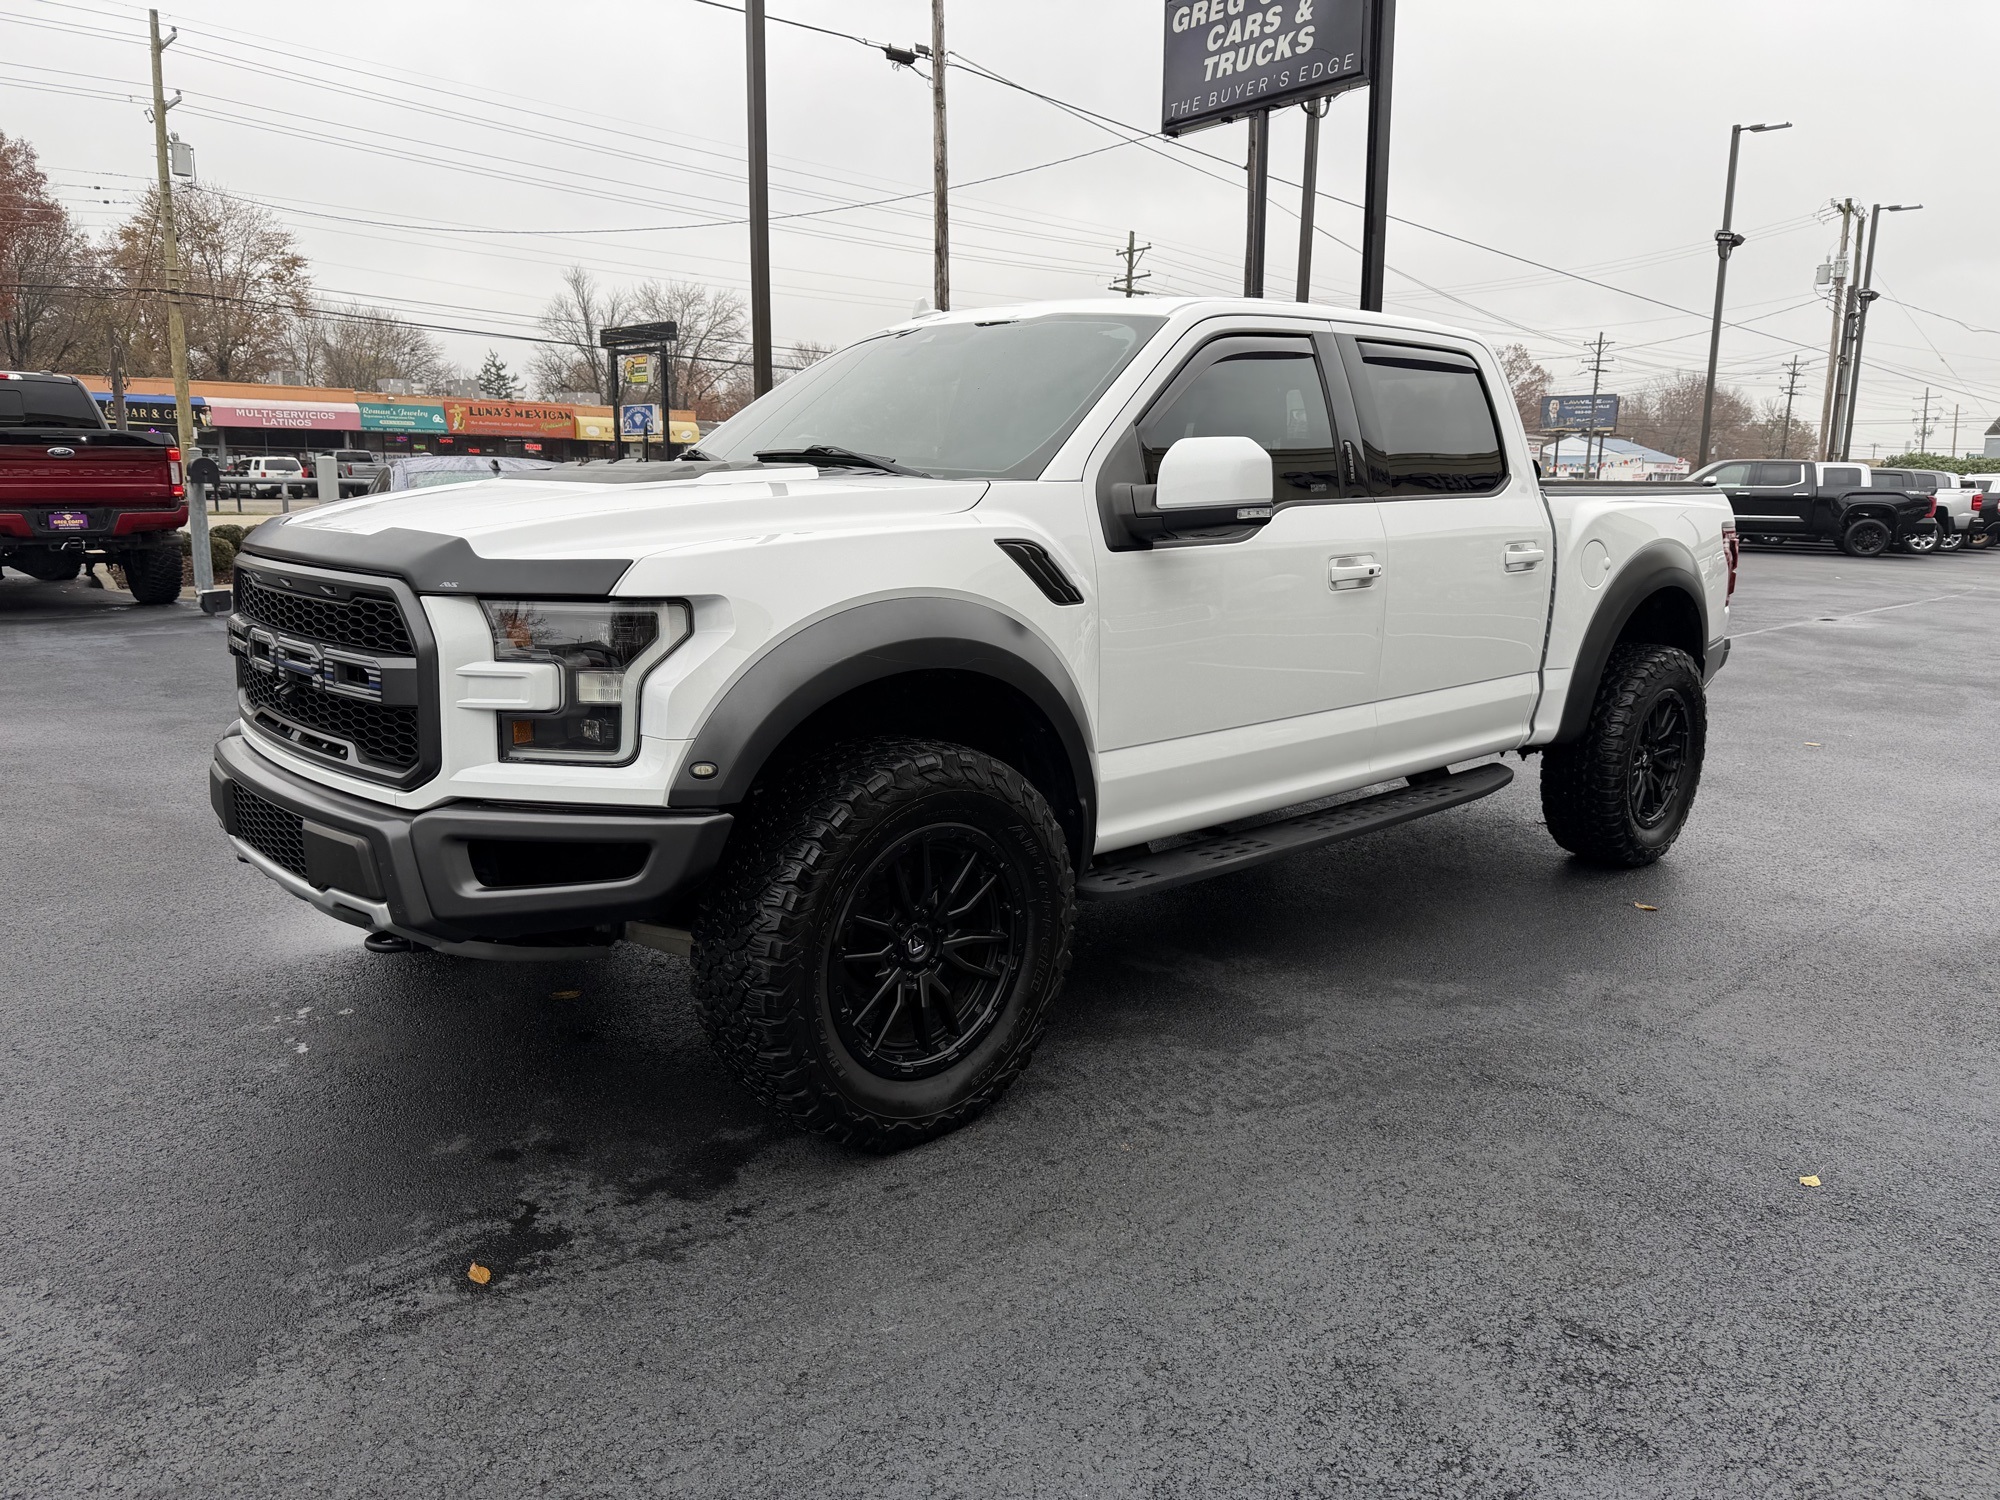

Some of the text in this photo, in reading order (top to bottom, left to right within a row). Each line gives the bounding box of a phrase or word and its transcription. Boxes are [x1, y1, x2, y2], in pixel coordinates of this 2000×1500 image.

[1172, 0, 1246, 33] GREG
[1206, 0, 1314, 52] CARS &
[1203, 25, 1316, 82] TRUCKS
[1170, 53, 1355, 117] THE BUYER'S EDGE
[151, 408, 160, 419] &
[235, 408, 336, 420] MULTI-SERVICIOS
[360, 406, 428, 418] Roman's Jewelry
[468, 406, 572, 420] LUNA'S MEXICAN
[262, 418, 312, 427] LATINOS
